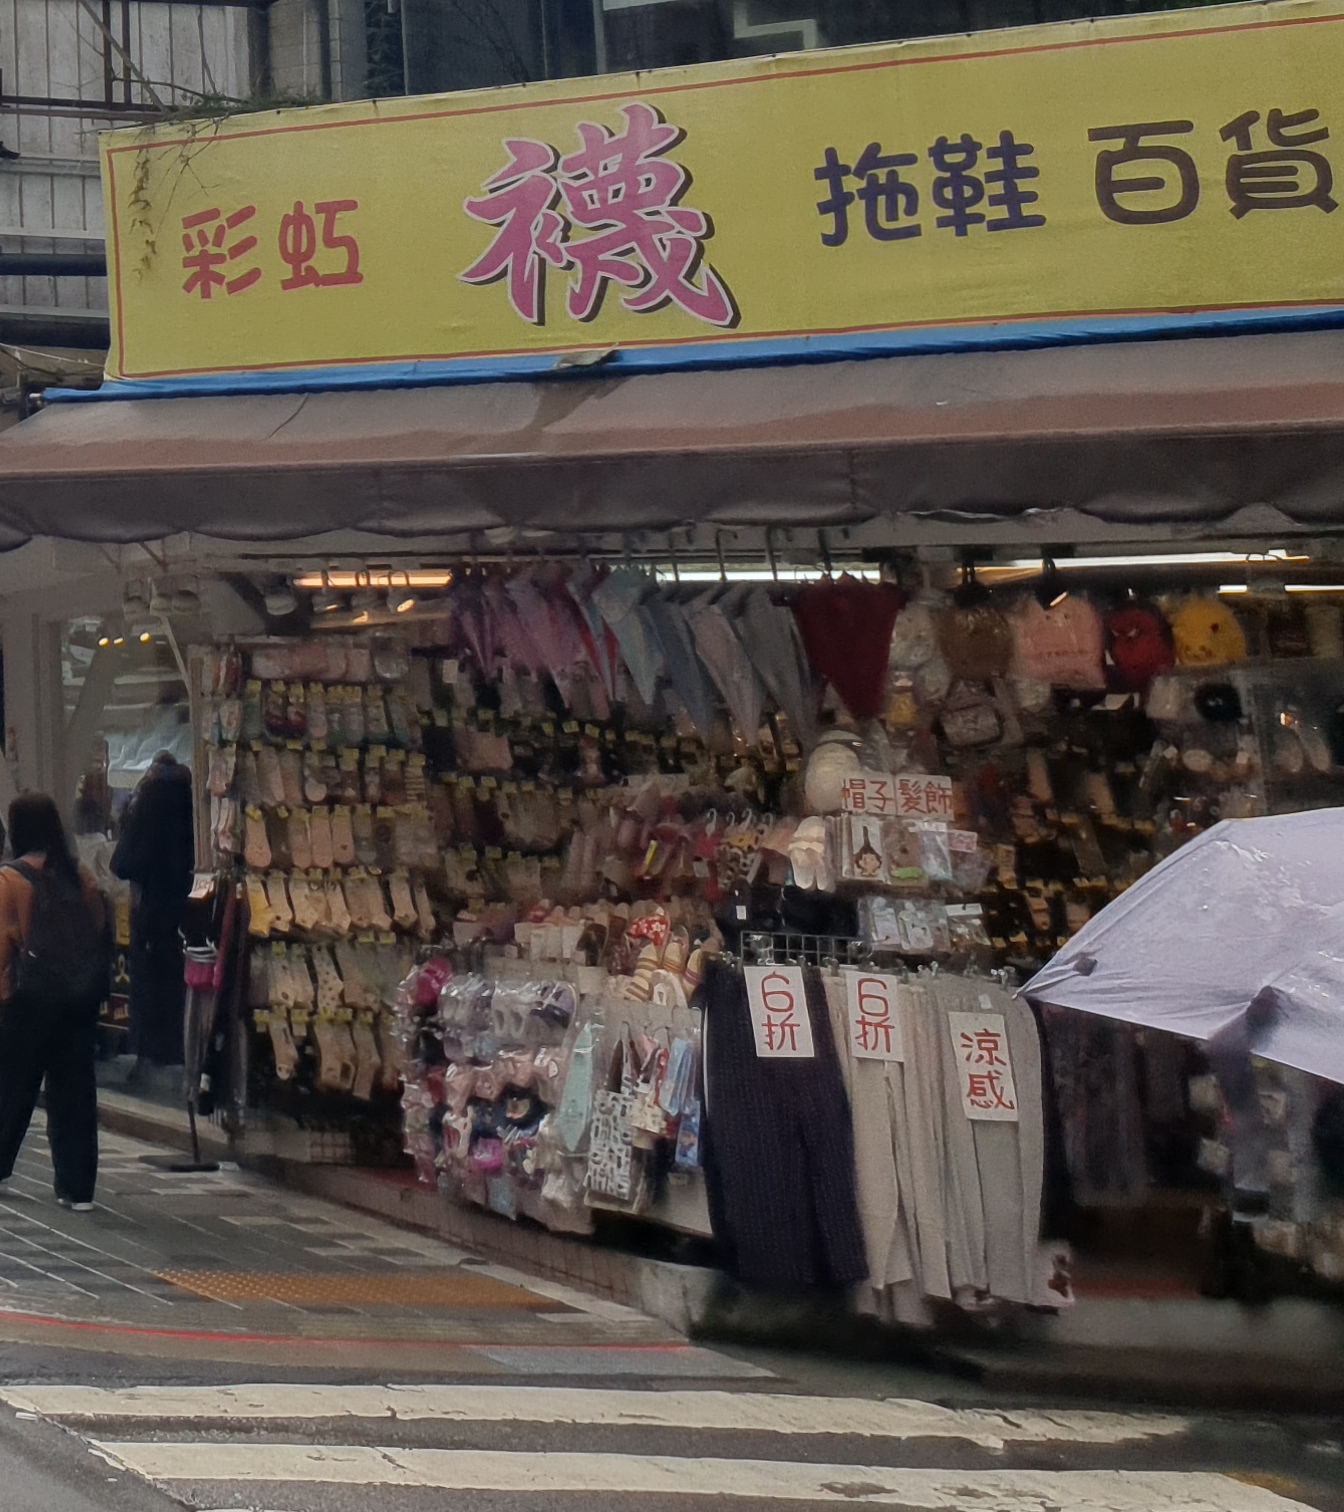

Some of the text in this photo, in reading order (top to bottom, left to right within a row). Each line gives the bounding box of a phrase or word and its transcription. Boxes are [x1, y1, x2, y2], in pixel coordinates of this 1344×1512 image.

[179, 101, 1339, 328] 彩虹 襪 拖鞋 百貨
[761, 971, 800, 1051] 6折
[855, 977, 895, 1053] 6折
[960, 1028, 1015, 1110] 涼感
